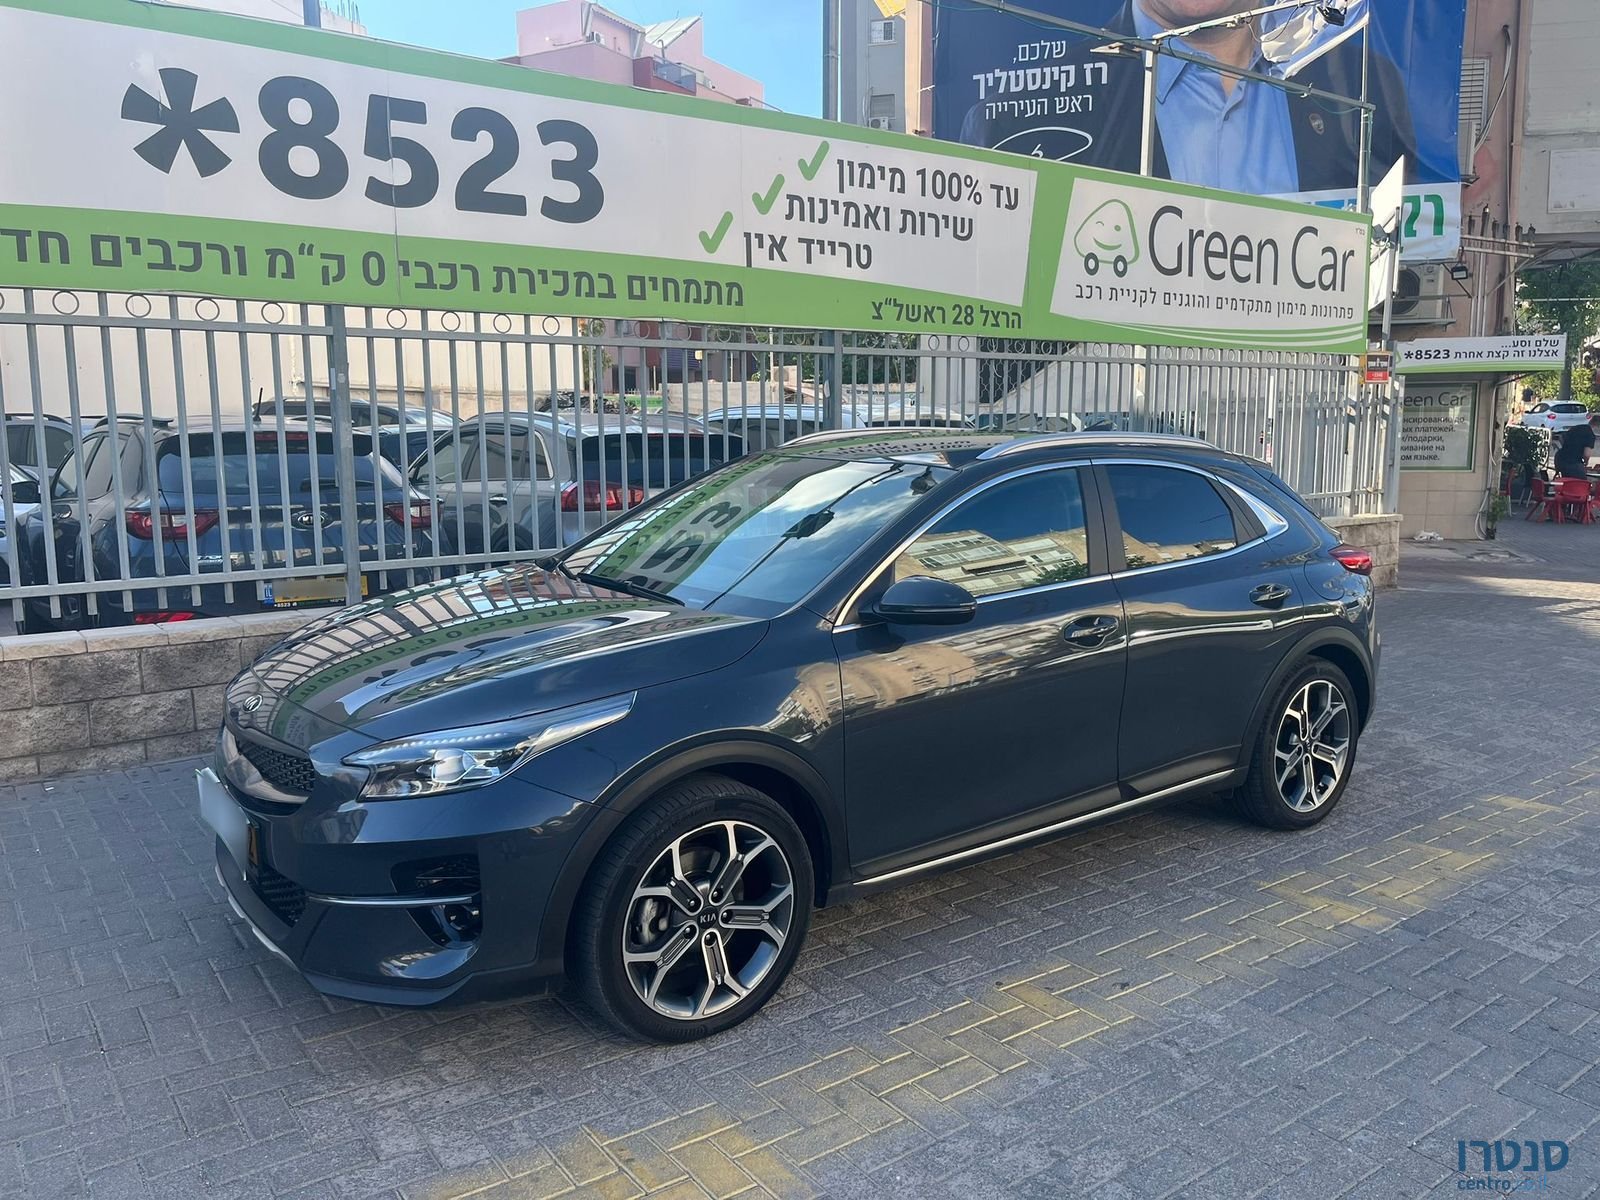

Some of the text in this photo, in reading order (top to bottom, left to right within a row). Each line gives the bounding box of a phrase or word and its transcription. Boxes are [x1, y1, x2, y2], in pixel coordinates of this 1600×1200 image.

[1013, 40, 1066, 64] שלכם,
[973, 62, 1108, 99] רז קינסטליך
[986, 95, 1093, 120] ראש העירייה
[837, 159, 1019, 211] עד 100% מימון
[785, 194, 973, 241] שירות ואמינות
[90, 234, 247, 276] ורכבים
[265, 242, 346, 286] ק"מ
[744, 232, 872, 269] טרייד אין
[1149, 205, 1355, 292] Green Car
[362, 251, 386, 287] 0
[399, 260, 480, 292] רכבי
[493, 266, 616, 299] במכירת
[628, 275, 744, 307] מתמחים
[1076, 284, 1354, 320] פתרונות מימון מתקדמים והוגנים לקניית רכב
[873, 298, 1022, 329] הרצל 28 ראשל"צ
[1454, 351, 1483, 359] אחרת
[1487, 350, 1509, 360] קצת
[1513, 350, 1526, 358] זה
[1529, 349, 1559, 357] אצלנו
[1535, 339, 1560, 347] שלם
[1439, 392, 1467, 407] Car
[1415, 425, 1456, 433] платежей.
[701, 913, 716, 924] KIA
